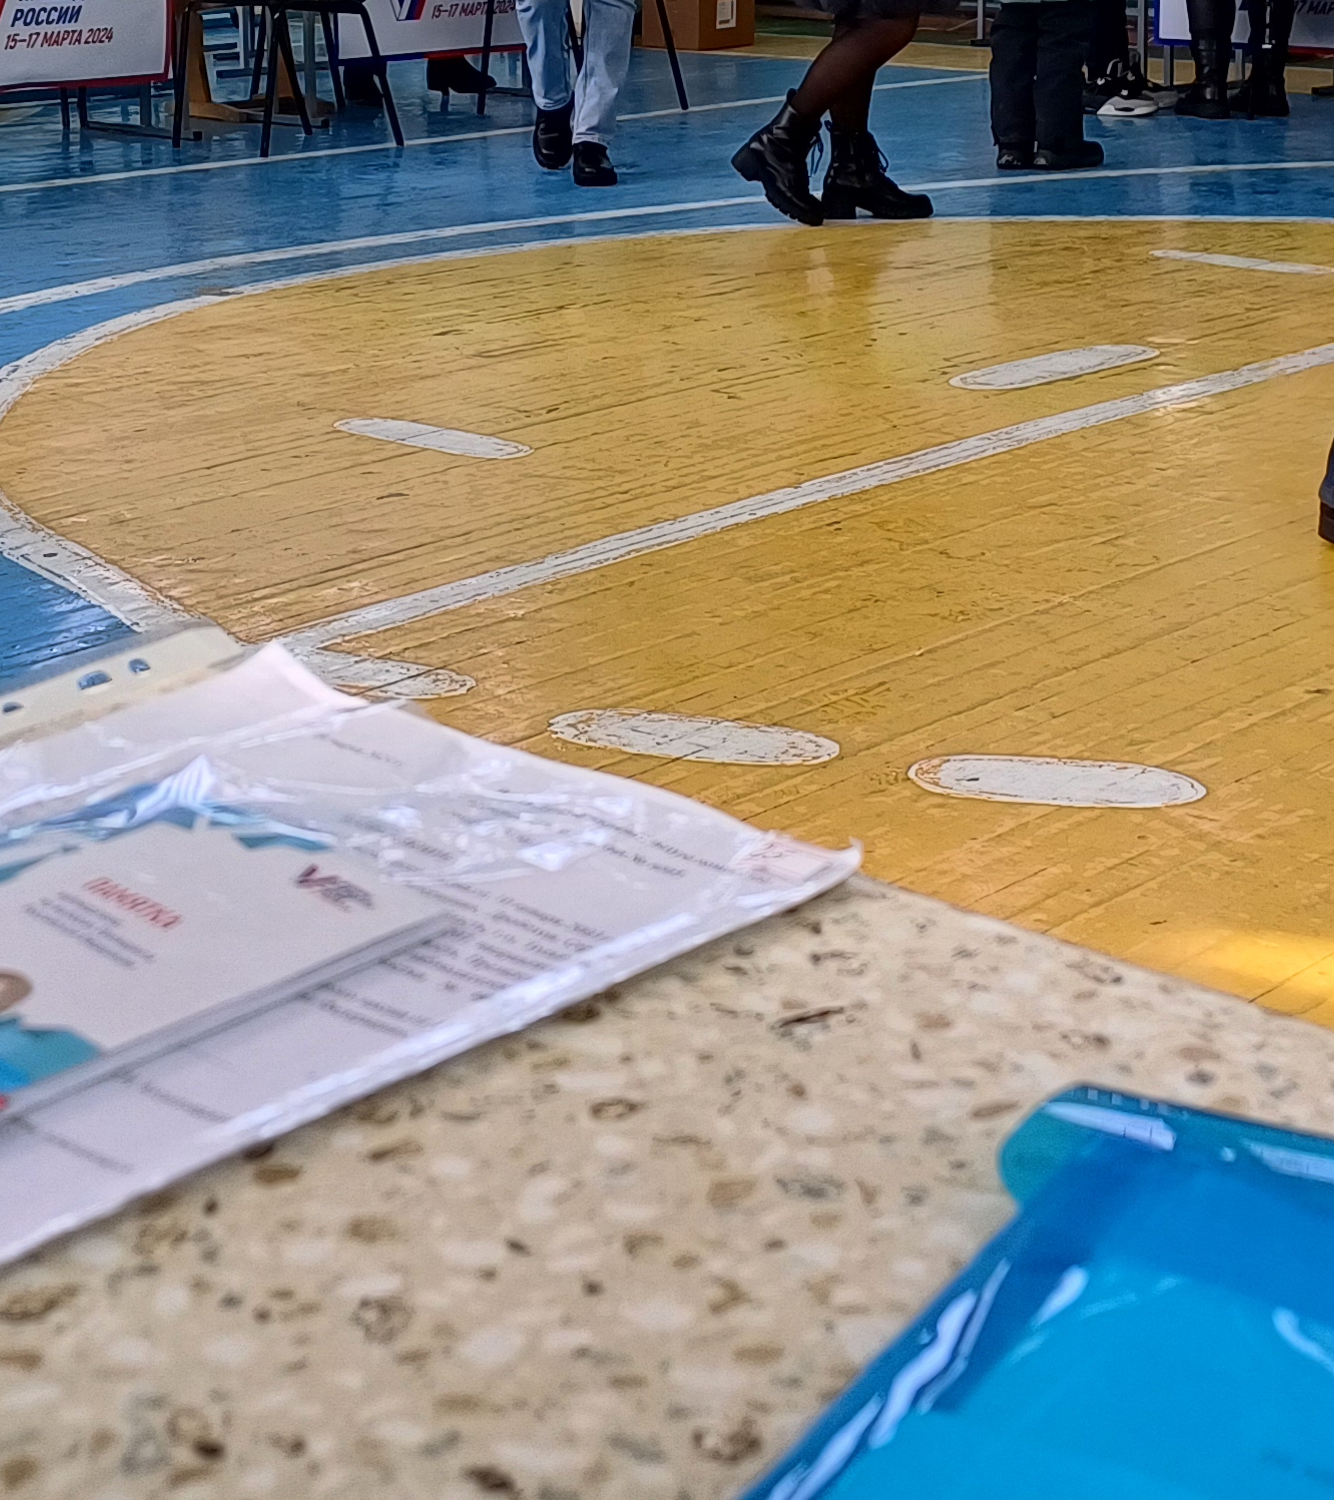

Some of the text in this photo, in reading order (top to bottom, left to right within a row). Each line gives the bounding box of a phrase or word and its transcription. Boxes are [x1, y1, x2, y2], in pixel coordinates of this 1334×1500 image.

[10, 5, 82, 27] РОССИИ
[459, 1, 490, 17] МАРТ
[40, 29, 83, 47] МАРТА
[84, 27, 113, 44] 2024
